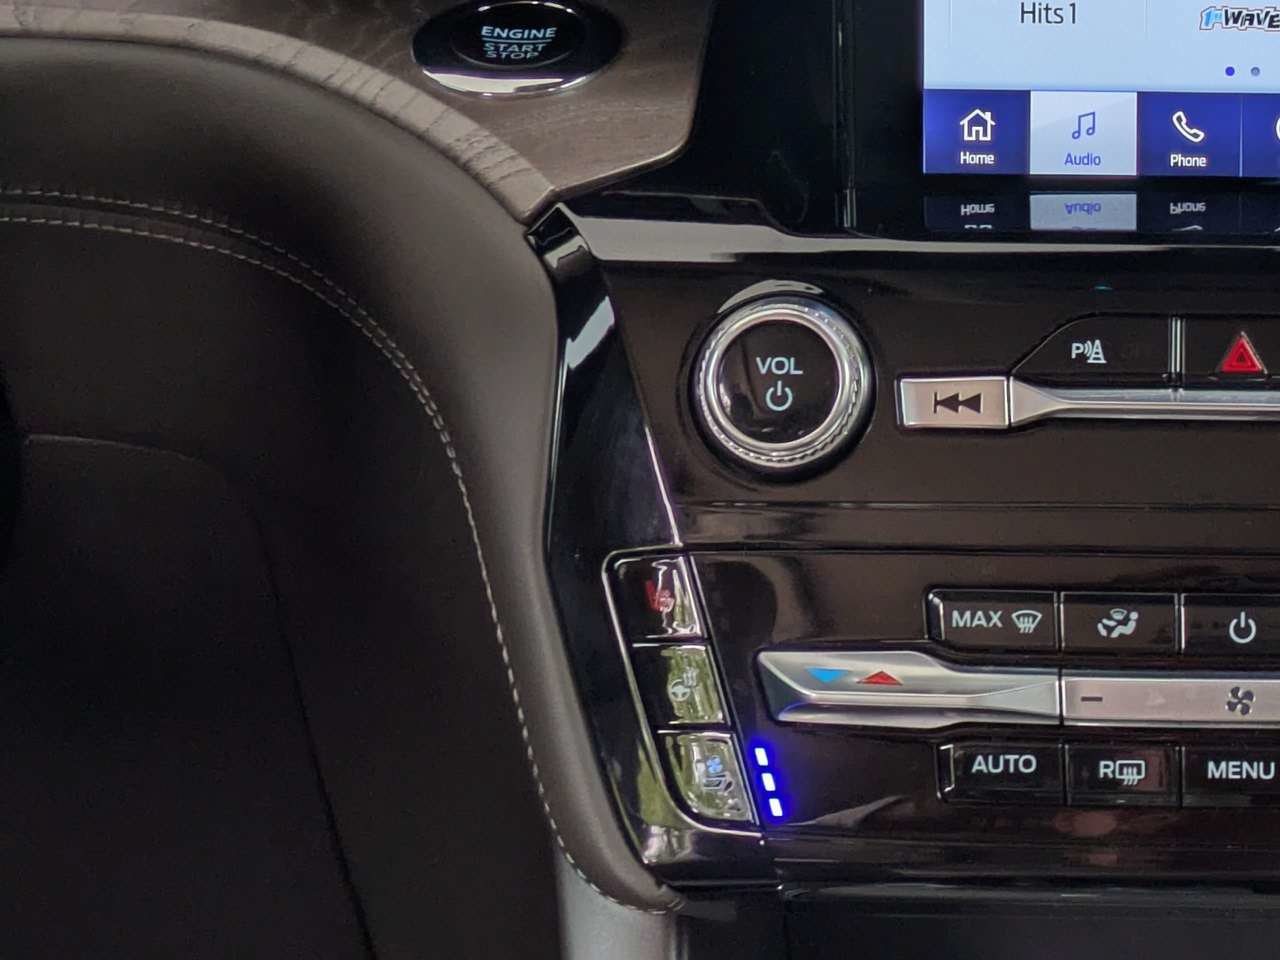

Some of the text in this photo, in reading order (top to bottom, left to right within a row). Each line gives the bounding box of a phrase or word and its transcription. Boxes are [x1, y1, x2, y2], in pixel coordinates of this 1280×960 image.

[1021, 2, 1063, 24] Hits
[481, 26, 557, 39] ENGINE
[483, 42, 547, 52] START
[484, 51, 540, 59] STOP
[961, 152, 994, 164] Home
[1064, 153, 1101, 165] Audio
[1171, 154, 1206, 166] Phone
[756, 357, 803, 374] VOL
[952, 610, 1002, 627] MAX
[972, 755, 1036, 773] AUTO
[1208, 761, 1275, 779] MENU
